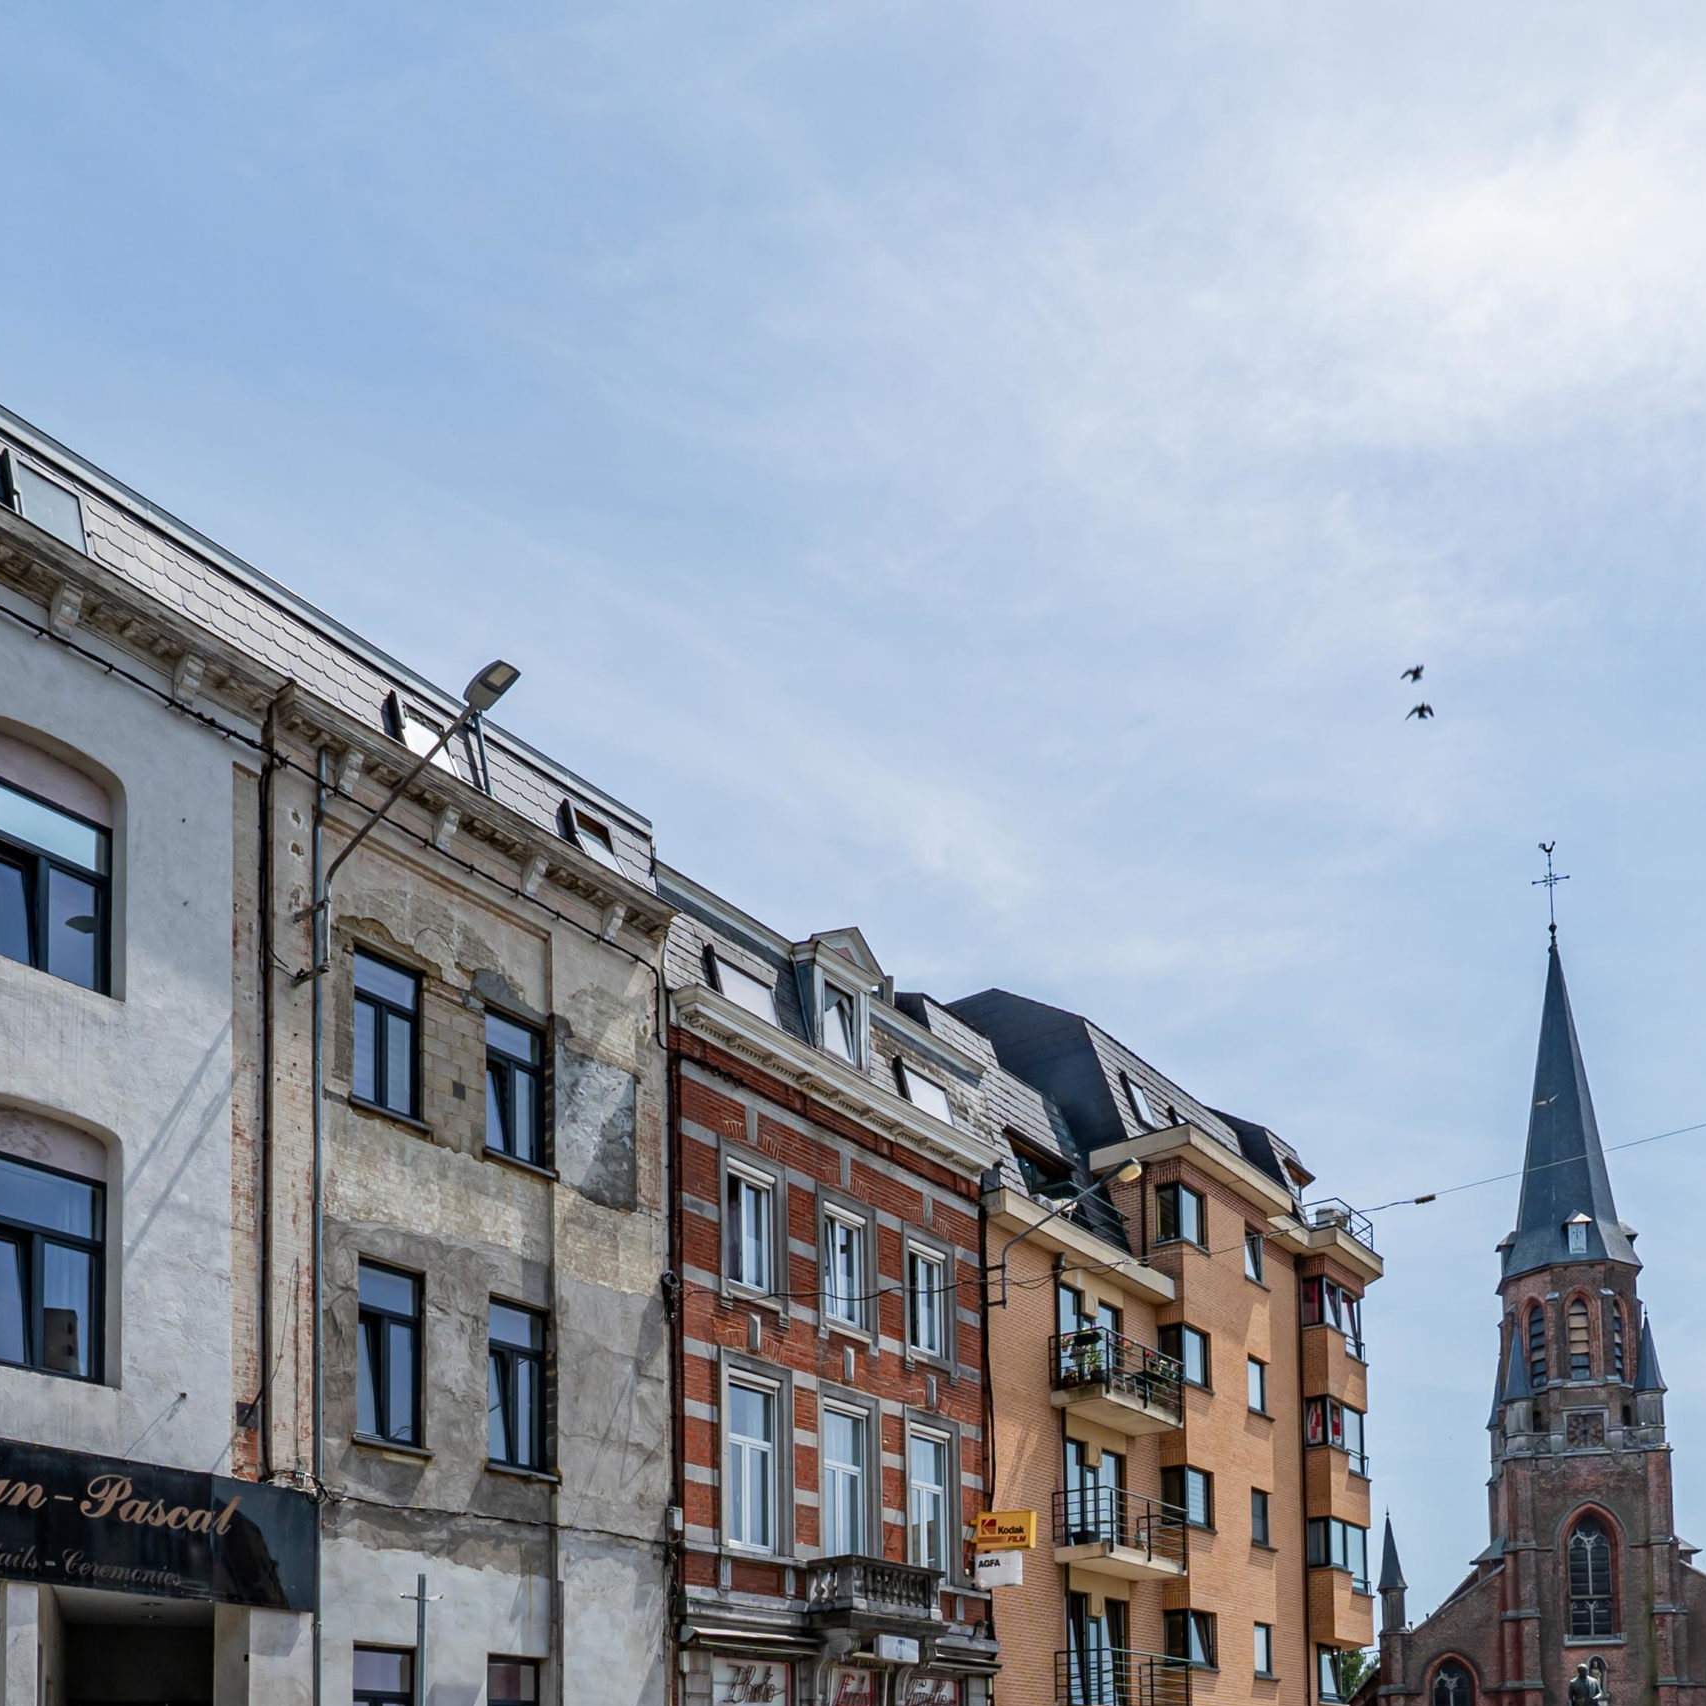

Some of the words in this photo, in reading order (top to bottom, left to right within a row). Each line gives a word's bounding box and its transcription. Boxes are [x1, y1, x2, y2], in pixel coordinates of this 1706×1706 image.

[997, 1525, 1025, 1535] Kodak
[1007, 1535, 1027, 1543] FILM
[978, 1558, 1001, 1568] AGFA
